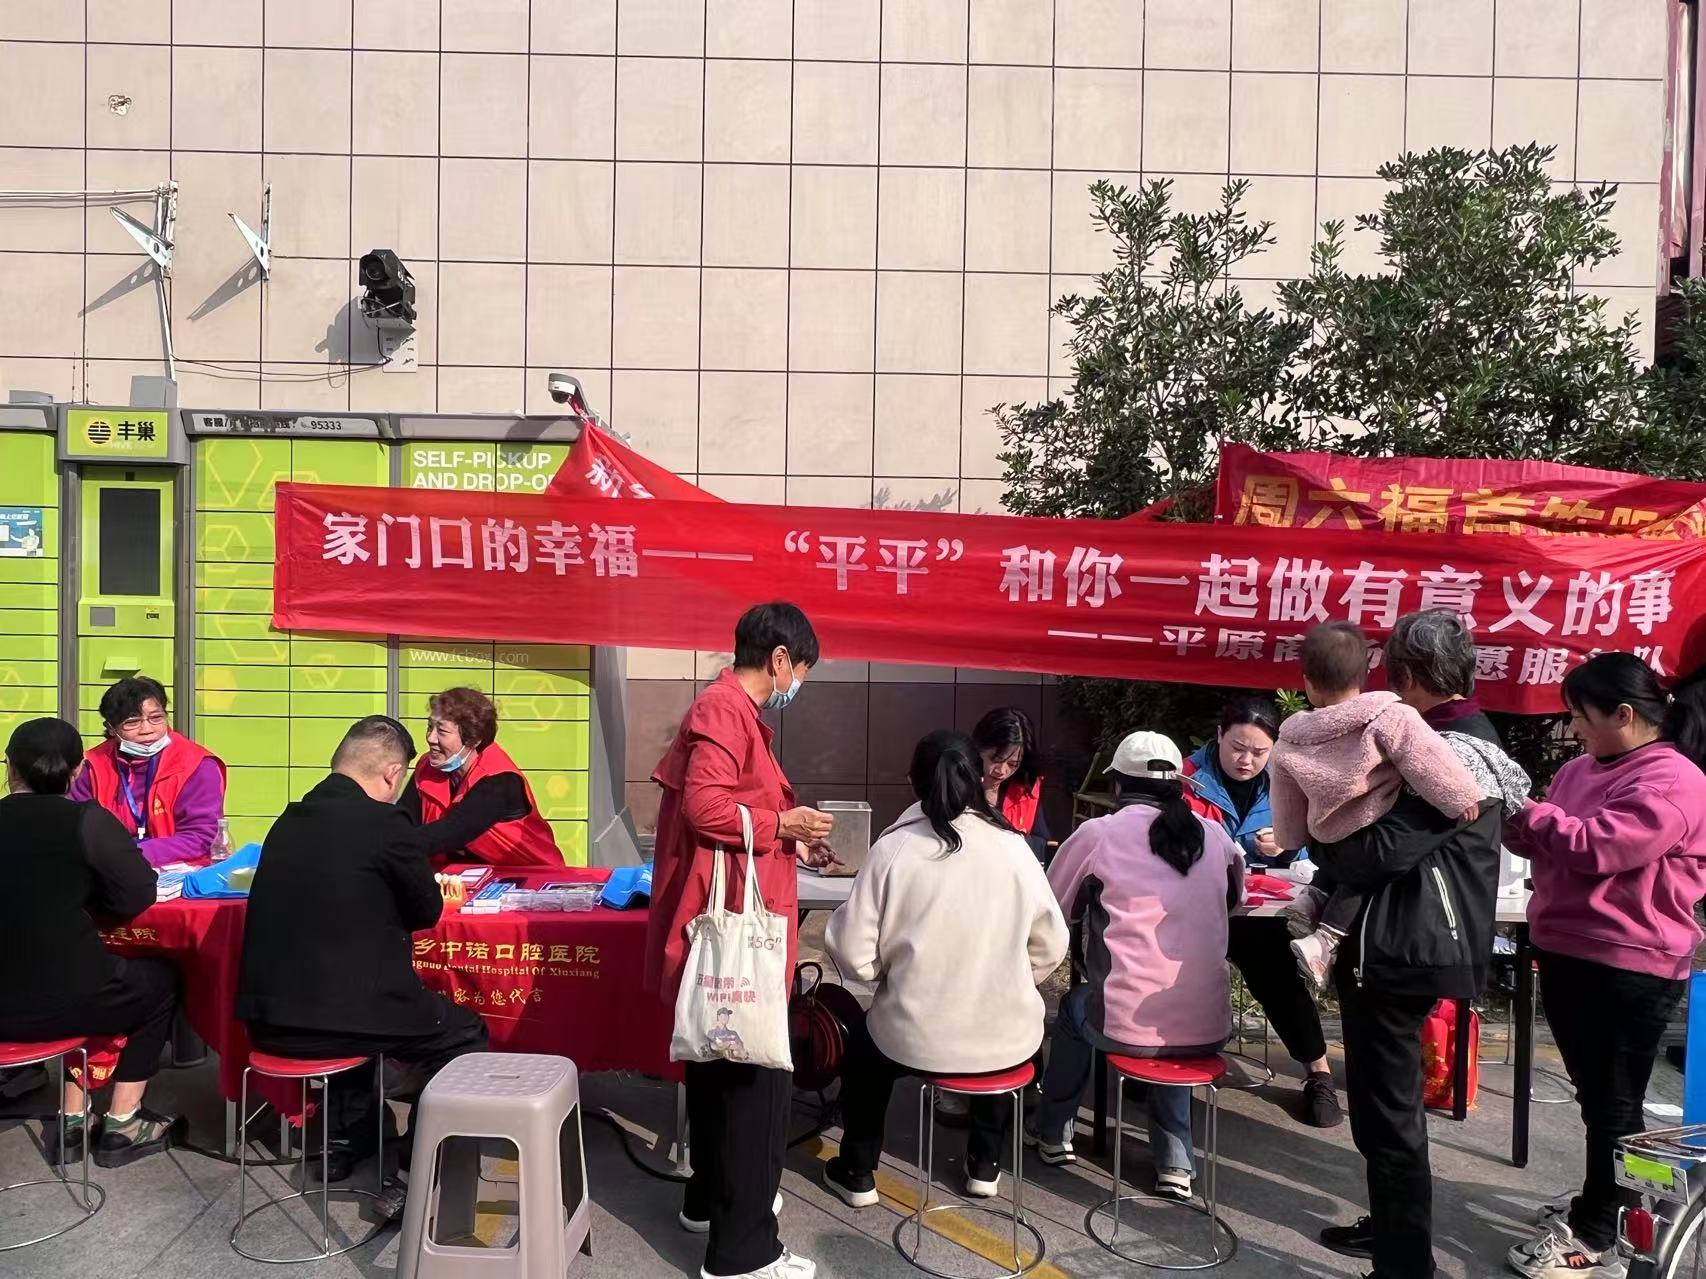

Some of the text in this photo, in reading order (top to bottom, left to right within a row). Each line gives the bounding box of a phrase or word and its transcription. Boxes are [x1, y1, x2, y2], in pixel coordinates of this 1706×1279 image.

[117, 420, 156, 441] 丰巢
[310, 420, 342, 431] 95333
[413, 450, 552, 469] SELF-PICKUP
[413, 472, 458, 489] AND
[999, 545, 1676, 637] 和你一起做有意义的事
[482, 965, 529, 977] Hospital
[532, 966, 545, 976] Of
